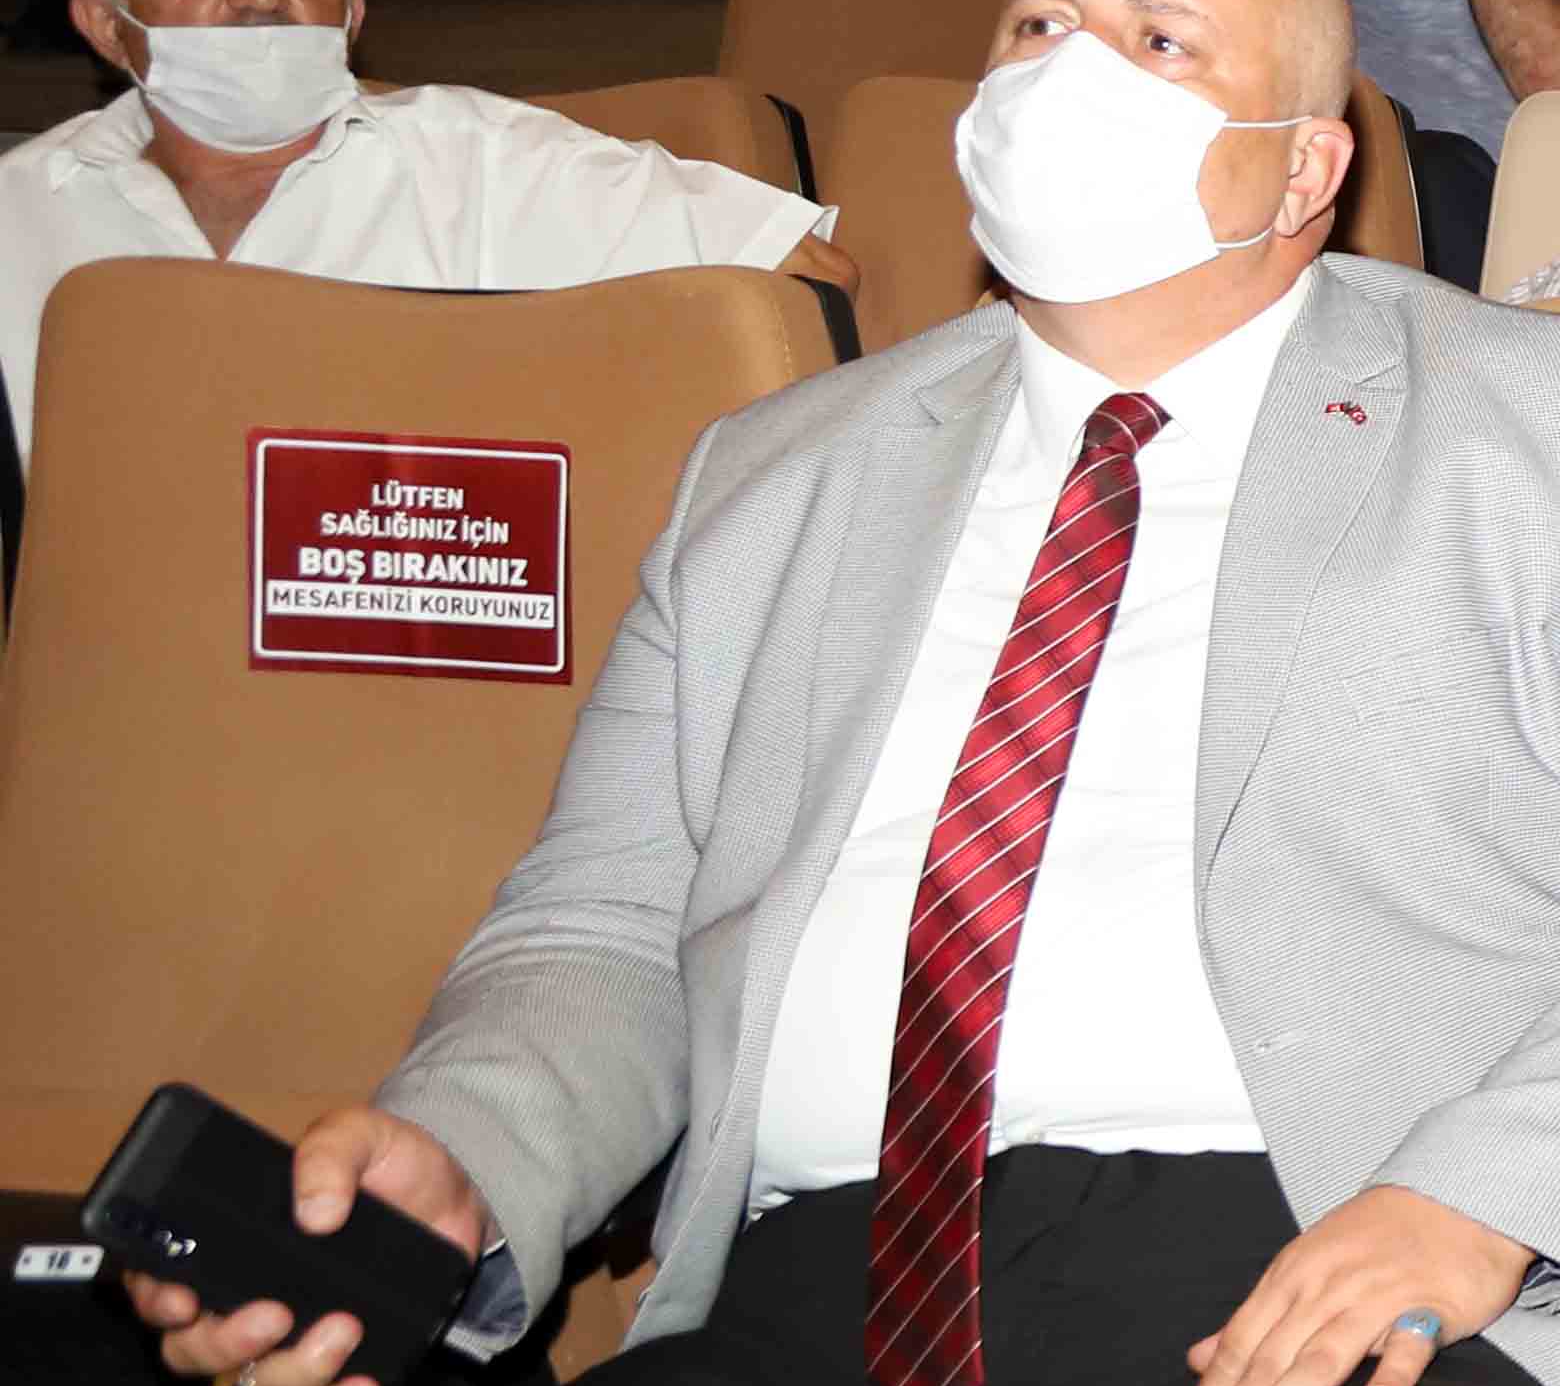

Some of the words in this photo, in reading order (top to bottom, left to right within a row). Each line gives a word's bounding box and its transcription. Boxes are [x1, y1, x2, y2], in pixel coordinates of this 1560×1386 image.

[371, 480, 464, 511] LÜTFEN
[320, 509, 457, 542] SAĞLIĞINIZ
[461, 516, 509, 549] İÇİN
[299, 547, 366, 584] BOŞ
[371, 551, 528, 587] BIRAKINIZ
[273, 589, 413, 612] MESAFENİZİ
[420, 596, 551, 620] KORUYUNUZ
